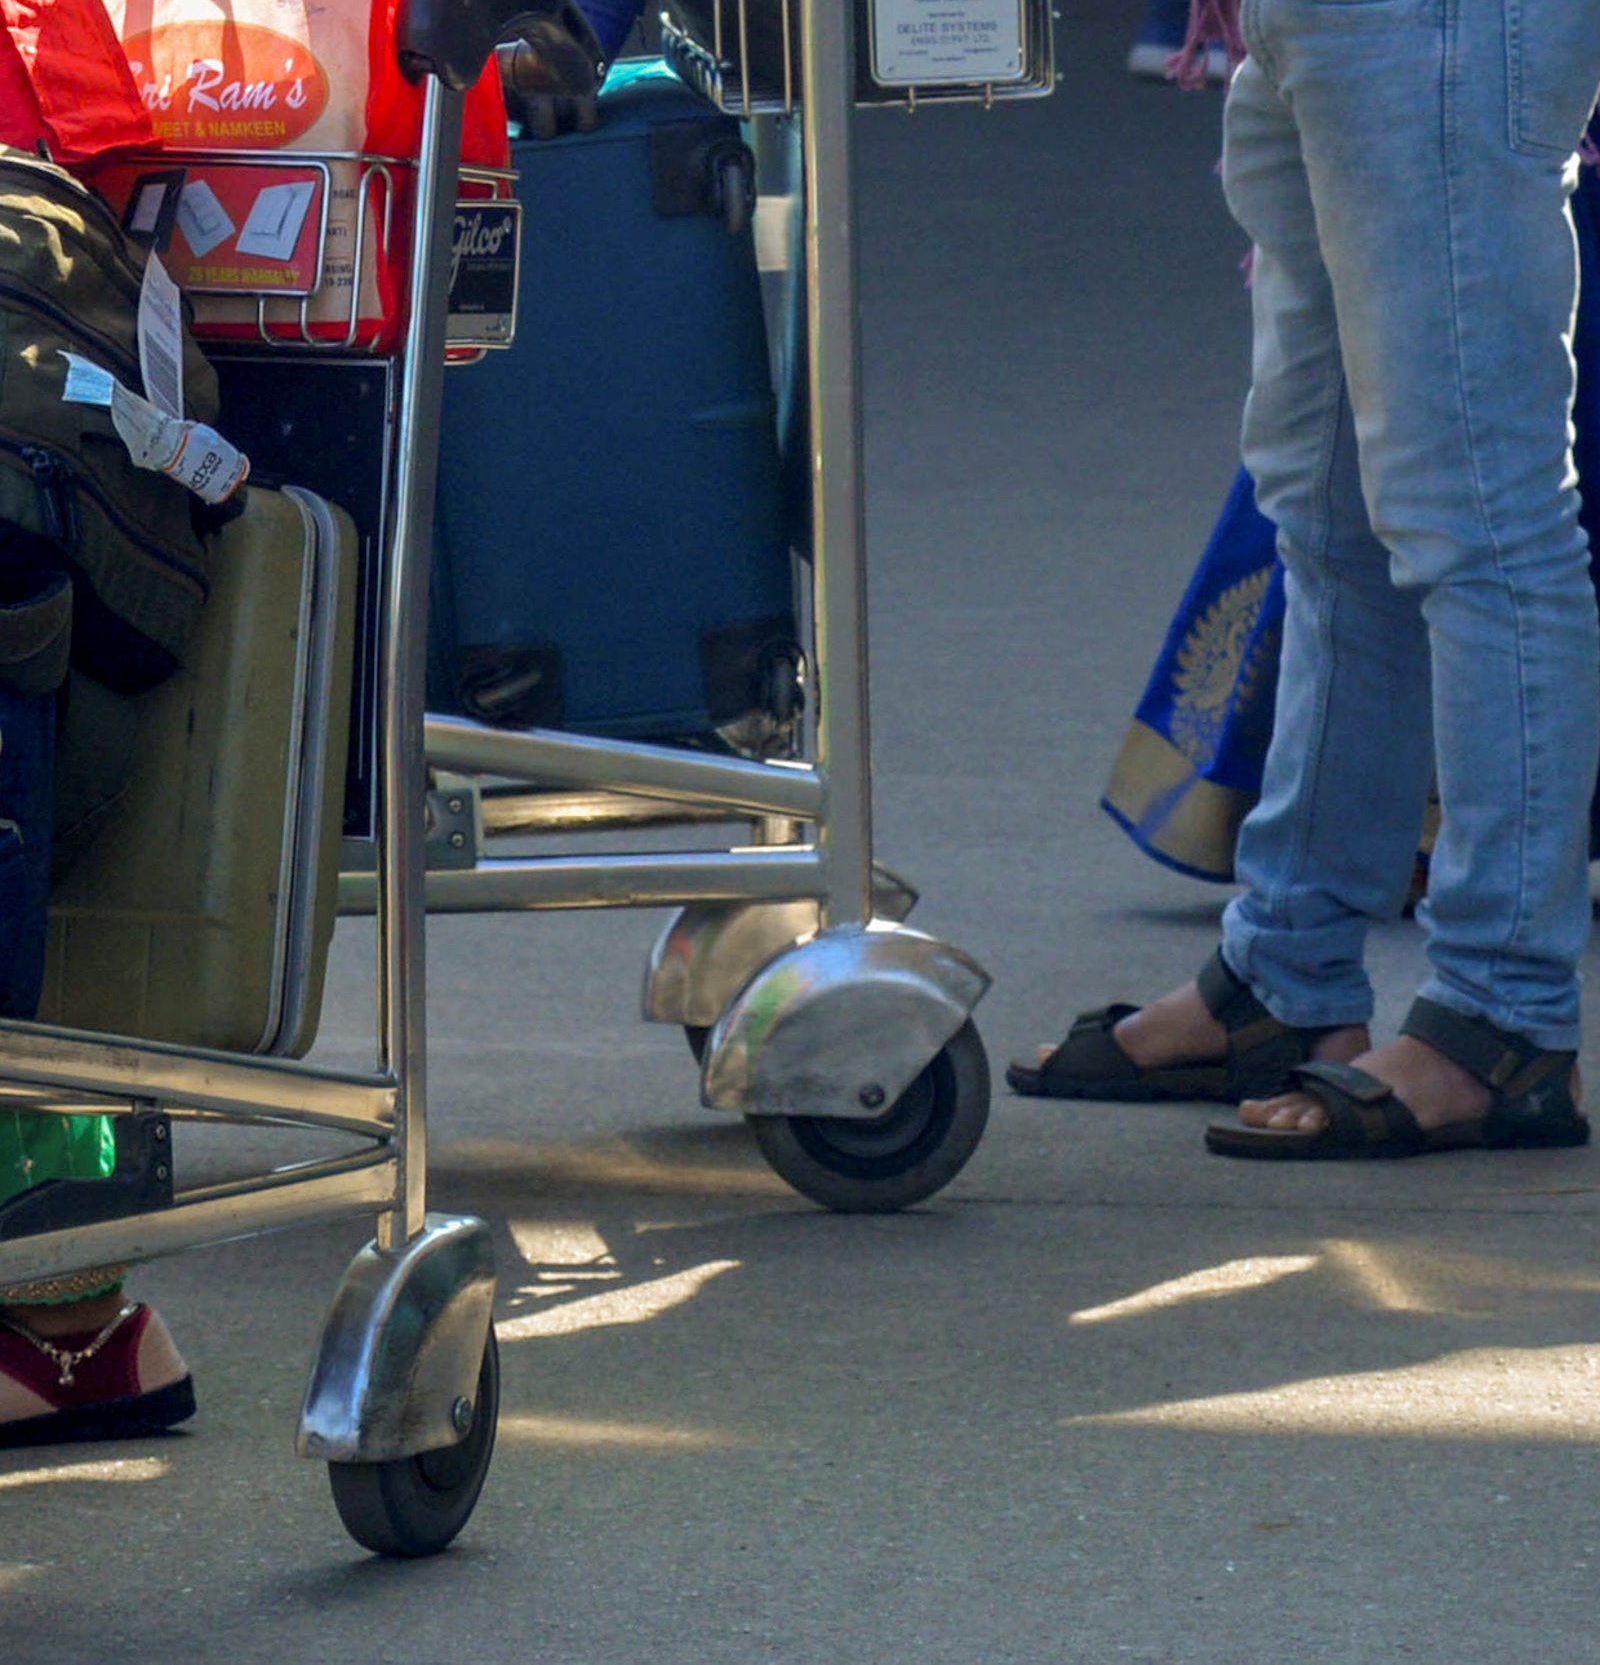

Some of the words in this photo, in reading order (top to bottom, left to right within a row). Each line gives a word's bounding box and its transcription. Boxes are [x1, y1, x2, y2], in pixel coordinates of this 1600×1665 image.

[186, 57, 308, 114] Ram's
[152, 120, 191, 138] WEET
[210, 119, 287, 138] NAMKEEN
